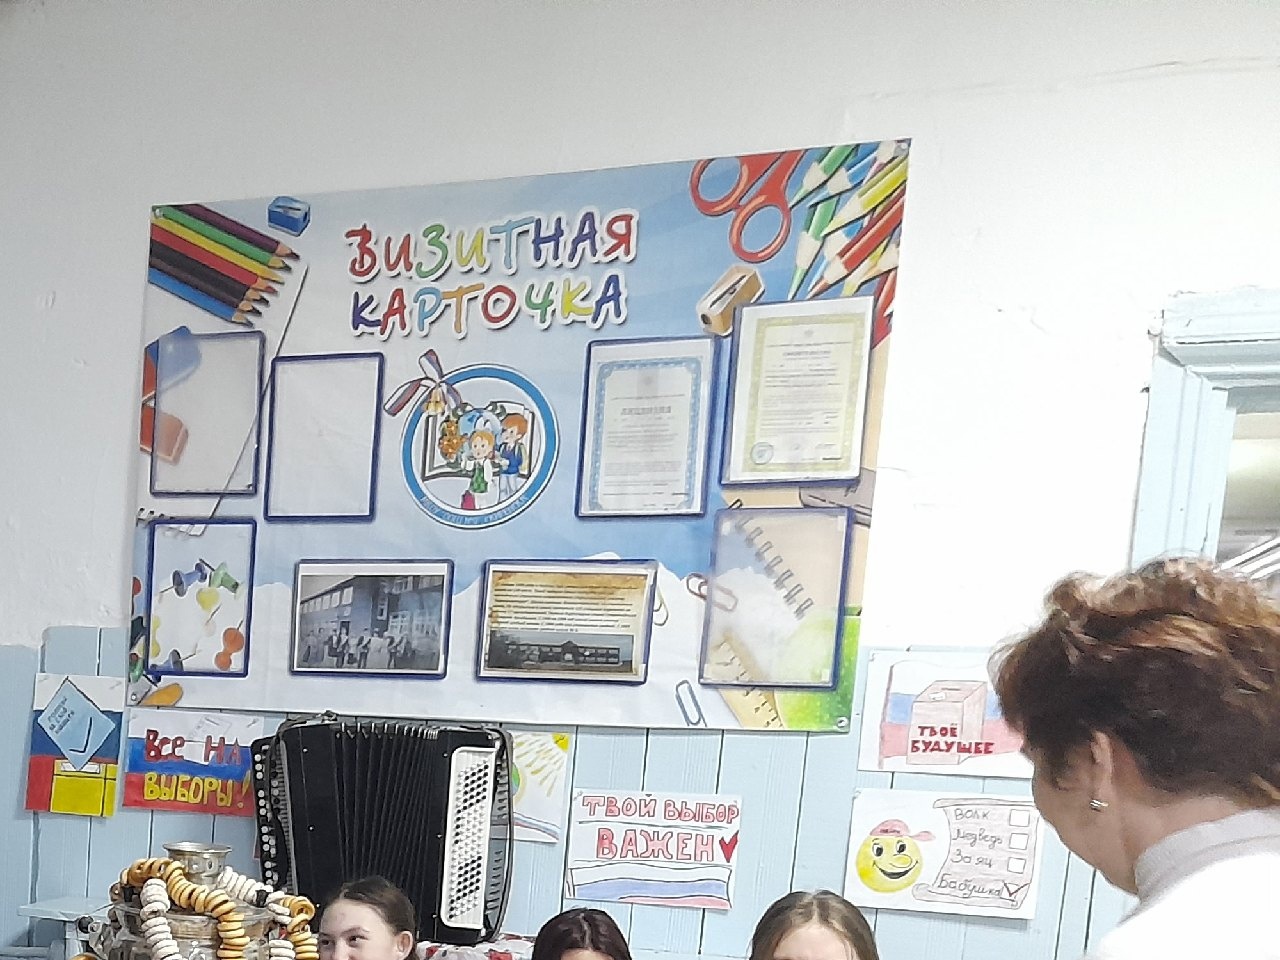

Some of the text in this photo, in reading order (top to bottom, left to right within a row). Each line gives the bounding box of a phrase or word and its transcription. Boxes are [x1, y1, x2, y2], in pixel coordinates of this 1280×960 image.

[345, 210, 635, 279] ВИЗИТНАЯ
[351, 273, 623, 336] КАРТОЧКА
[203, 735, 242, 765] НА
[910, 739, 995, 755] БУДУЩЕЕ
[143, 769, 252, 809] ВЫБОРЫ!
[581, 793, 740, 824] ТВОЙ ВЫБОР
[595, 827, 715, 862] ВАЖЕН
